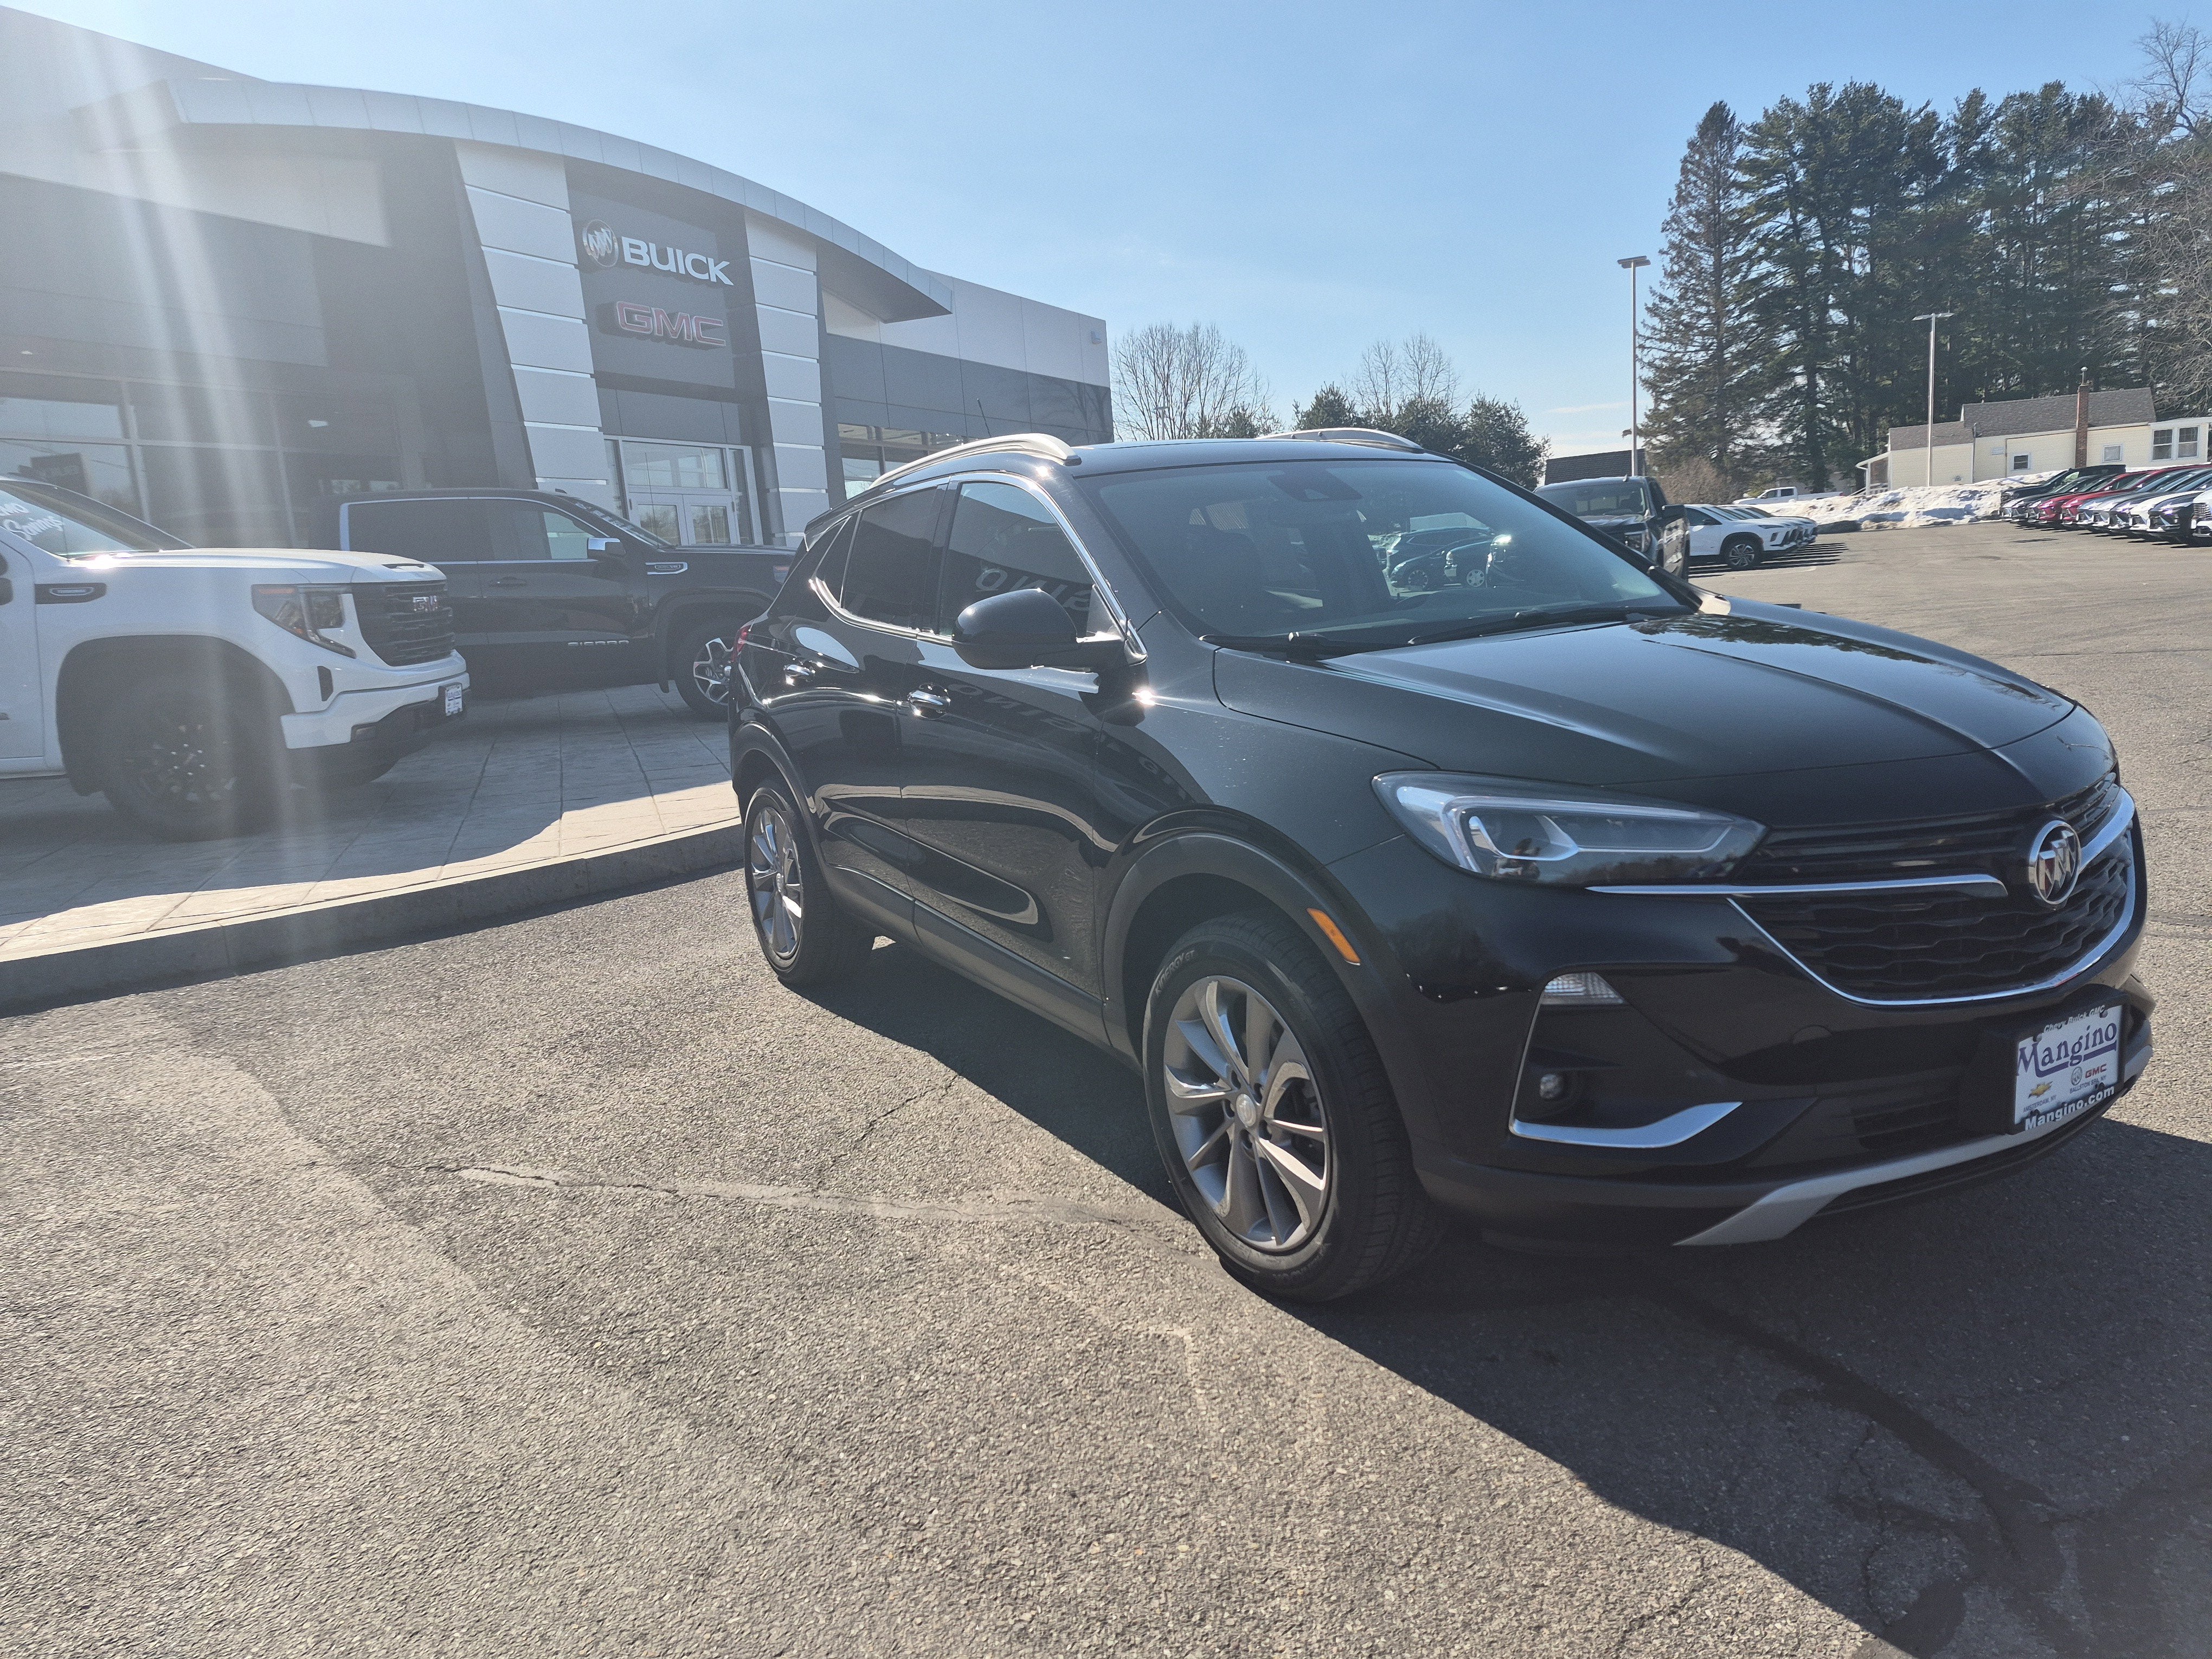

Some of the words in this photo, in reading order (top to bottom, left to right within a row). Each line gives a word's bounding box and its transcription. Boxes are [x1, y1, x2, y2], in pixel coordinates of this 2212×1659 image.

[621, 236, 734, 286] BUICK
[616, 301, 726, 346] GMC
[1155, 953, 1185, 995] KINERGY
[2068, 1011, 2087, 1024] Buick
[2088, 1005, 2105, 1016] GMC
[2016, 1023, 2117, 1077] Mangino
[2085, 1064, 2107, 1078] GMC
[2025, 1086, 2114, 1131] Mangino.com
[2069, 1081, 2090, 1094] BALLSTON
